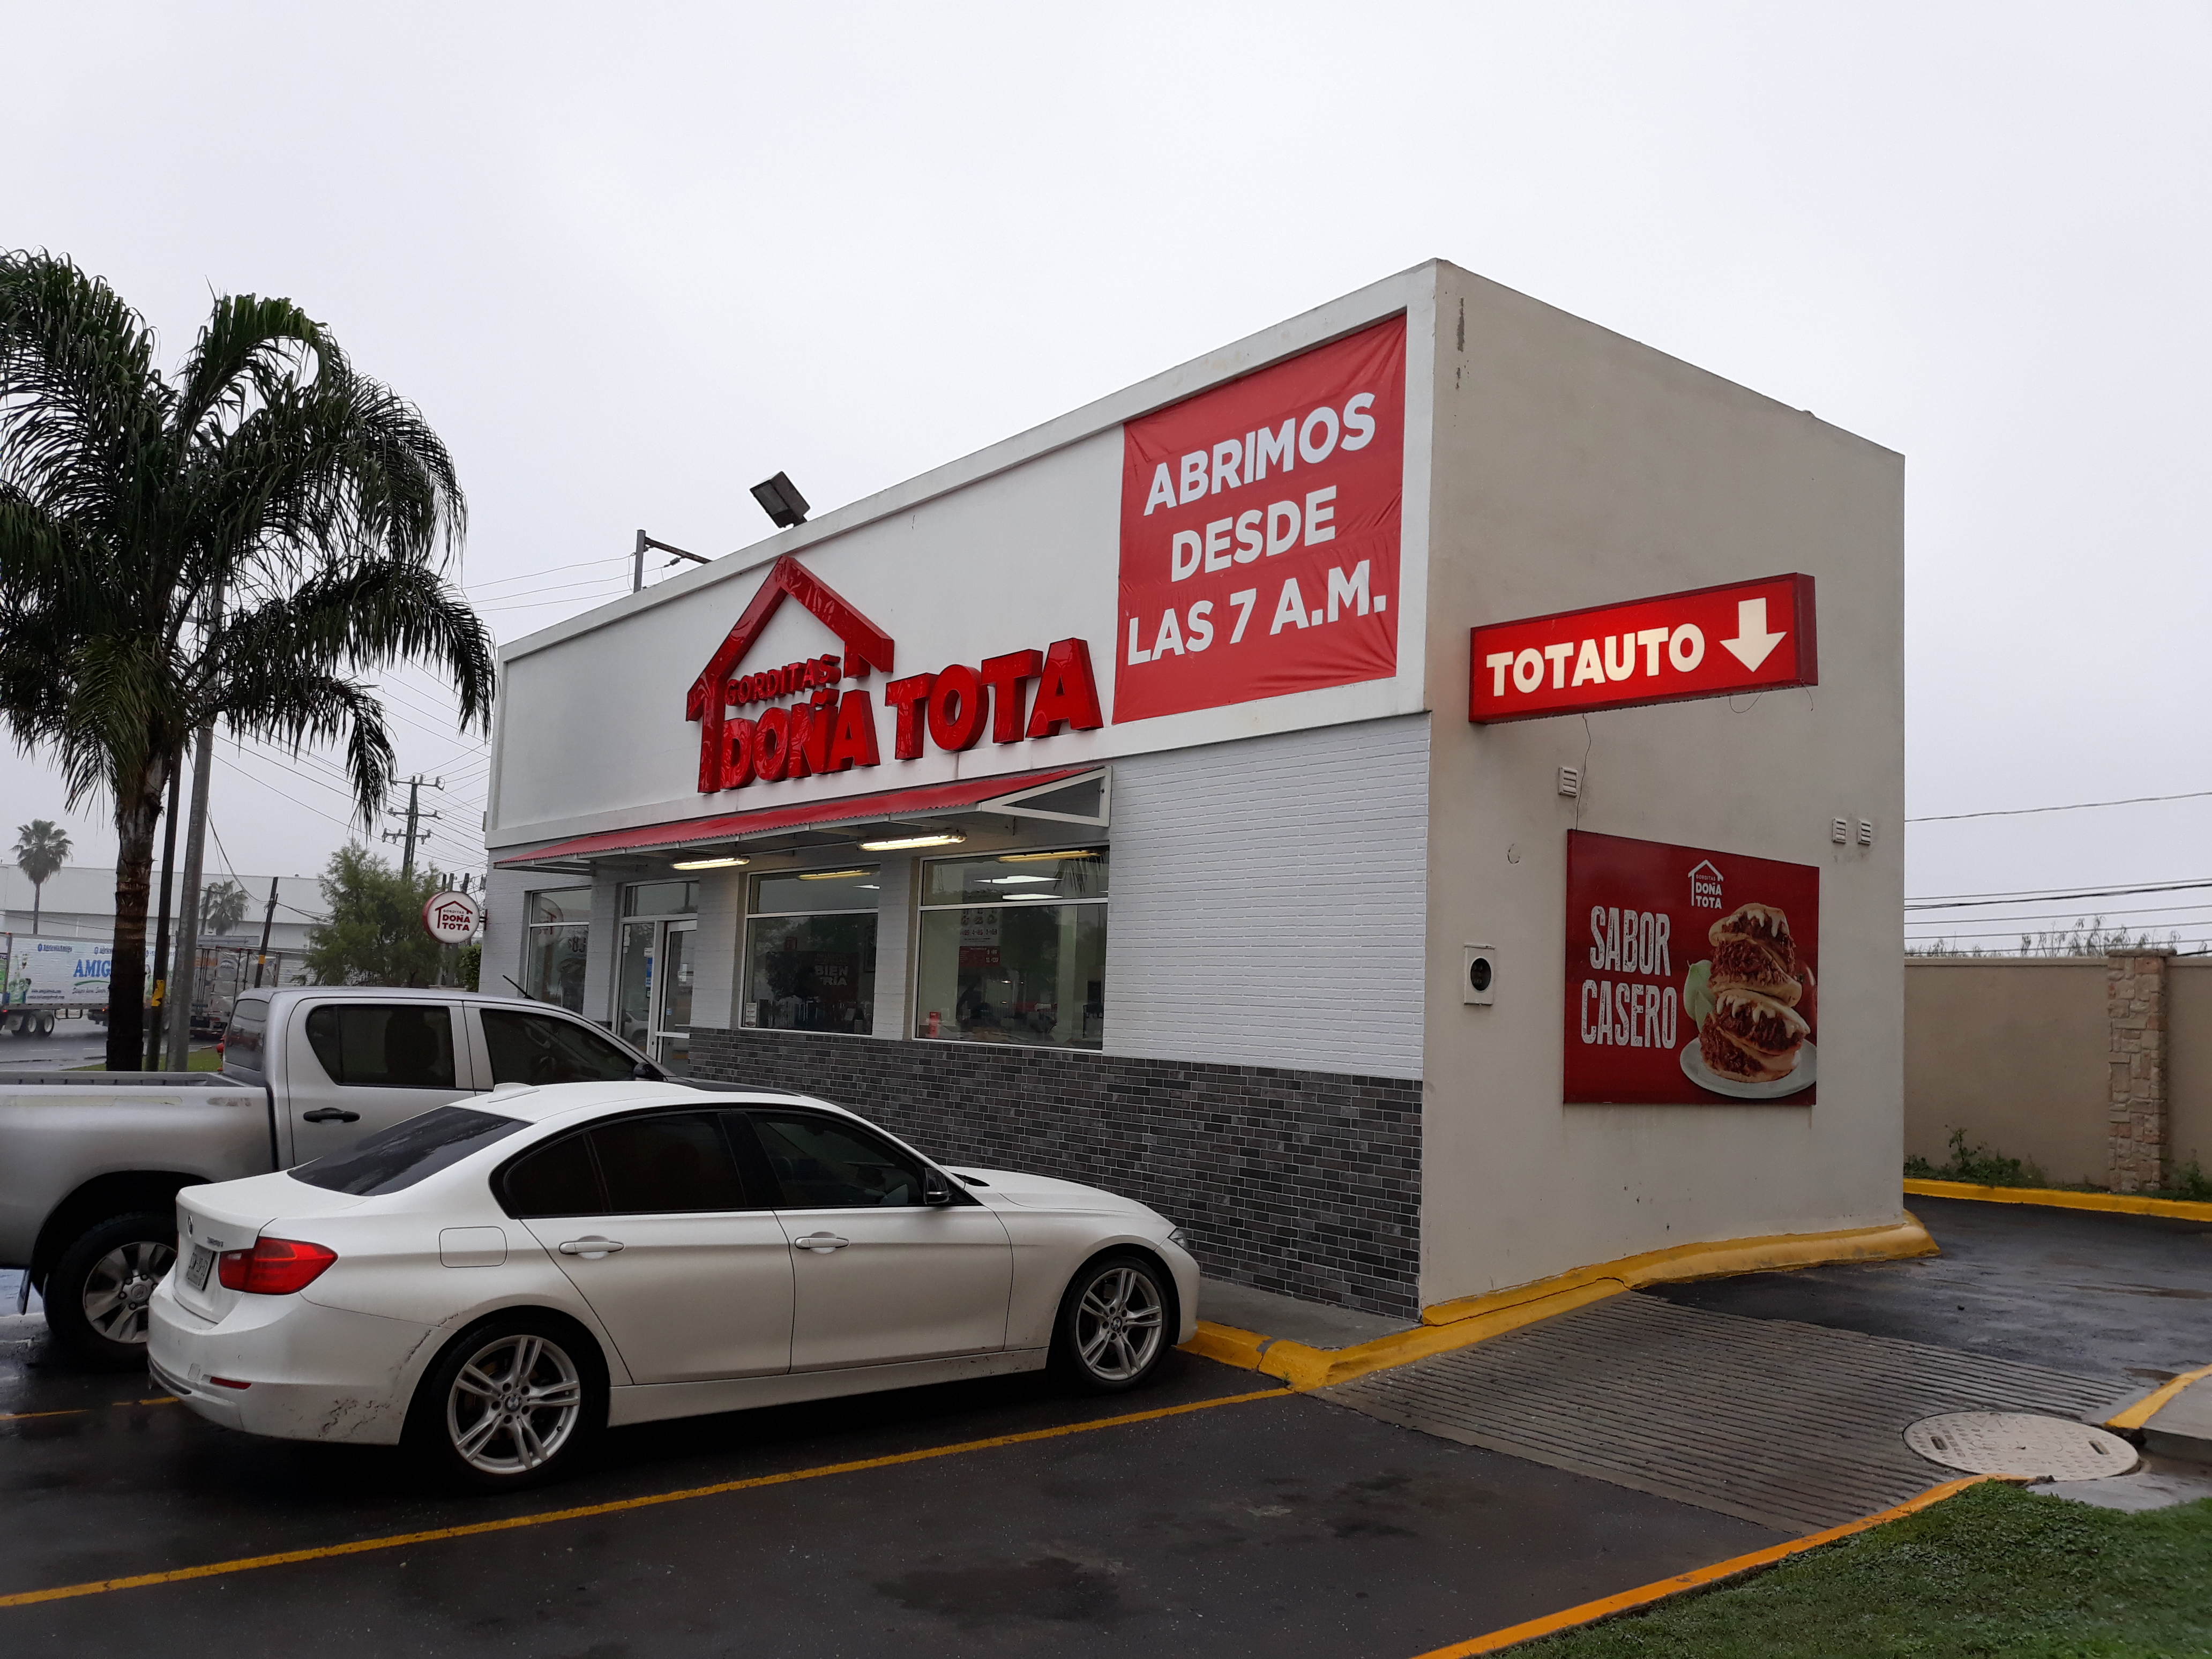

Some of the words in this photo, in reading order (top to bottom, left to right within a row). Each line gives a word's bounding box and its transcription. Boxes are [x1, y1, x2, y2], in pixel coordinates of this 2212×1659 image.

[1144, 392, 1376, 516] ABRIMOS
[1171, 484, 1336, 582] DESDE
[1128, 600, 1214, 666] LAS
[1230, 588, 1256, 644] 7
[1270, 559, 1387, 635] A.M.
[725, 653, 841, 707] GORDITAS
[1486, 623, 1705, 697] TOTAUTO
[720, 688, 880, 789] DOÑA
[885, 637, 1104, 760] TOTA
[443, 914, 470, 923] DOÑA
[1695, 882, 1722, 895] DOÑA
[1695, 895, 1722, 909] TOTA
[442, 922, 469, 931] TOTA
[1590, 906, 1671, 976] SABOR
[73, 959, 111, 978] AMIG
[814, 965, 849, 976] BIEN
[1581, 979, 1677, 1049] CASERO
